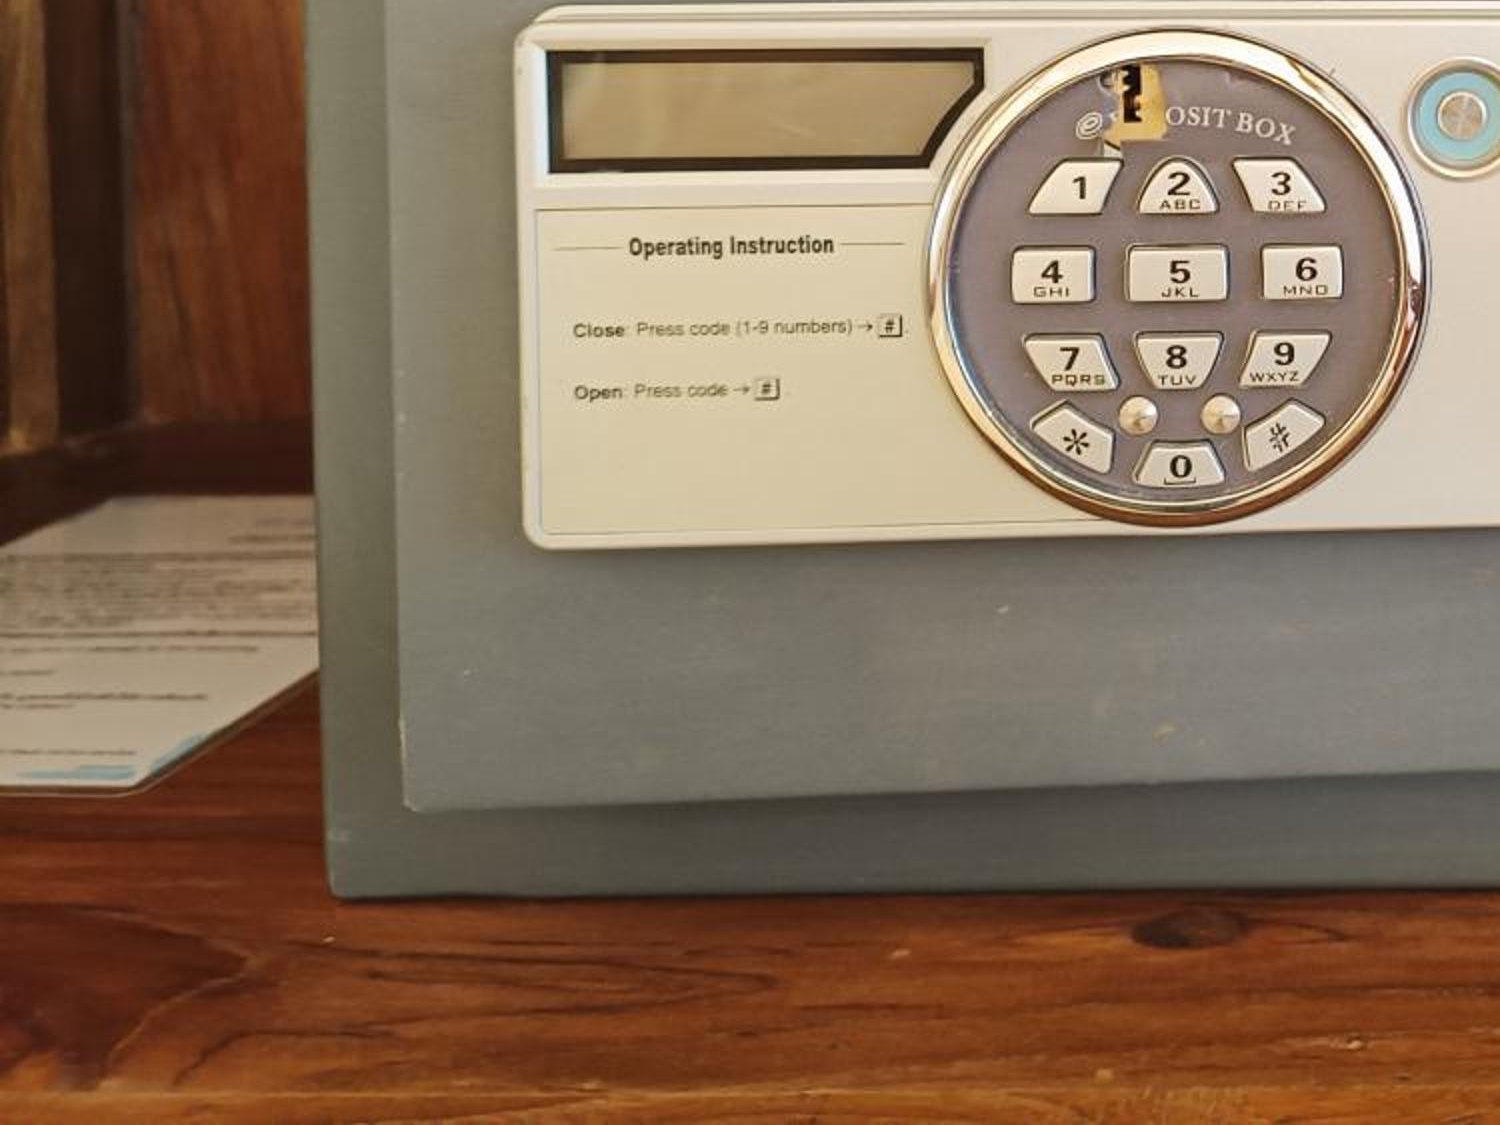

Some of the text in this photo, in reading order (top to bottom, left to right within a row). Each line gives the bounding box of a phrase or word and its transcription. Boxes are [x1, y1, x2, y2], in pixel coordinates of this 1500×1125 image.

[1235, 112, 1297, 146] BOX
[1073, 176, 1087, 200] 1
[1167, 172, 1191, 196] 2
[1271, 172, 1292, 196] 3
[1159, 198, 1201, 211] ABC
[628, 234, 835, 261] Operating Instruction
[1041, 260, 1064, 284] 4
[1169, 260, 1191, 284] 5
[1295, 257, 1318, 282] 6
[1033, 286, 1070, 298] GHI
[1161, 286, 1199, 298] JKL
[1282, 284, 1329, 296] MNO
[636, 321, 685, 337] Press
[689, 322, 731, 337] code
[735, 320, 770, 337] (1-9
[773, 318, 853, 336] numbers)
[1059, 347, 1080, 371] 7
[1166, 345, 1188, 370] 8
[1273, 342, 1295, 366] 9
[1051, 374, 1106, 386] PQRS
[1157, 374, 1197, 386] TUV
[1249, 370, 1299, 383] WXYZ
[633, 383, 683, 398] Press
[687, 383, 729, 398] code
[1169, 454, 1193, 479] 0
